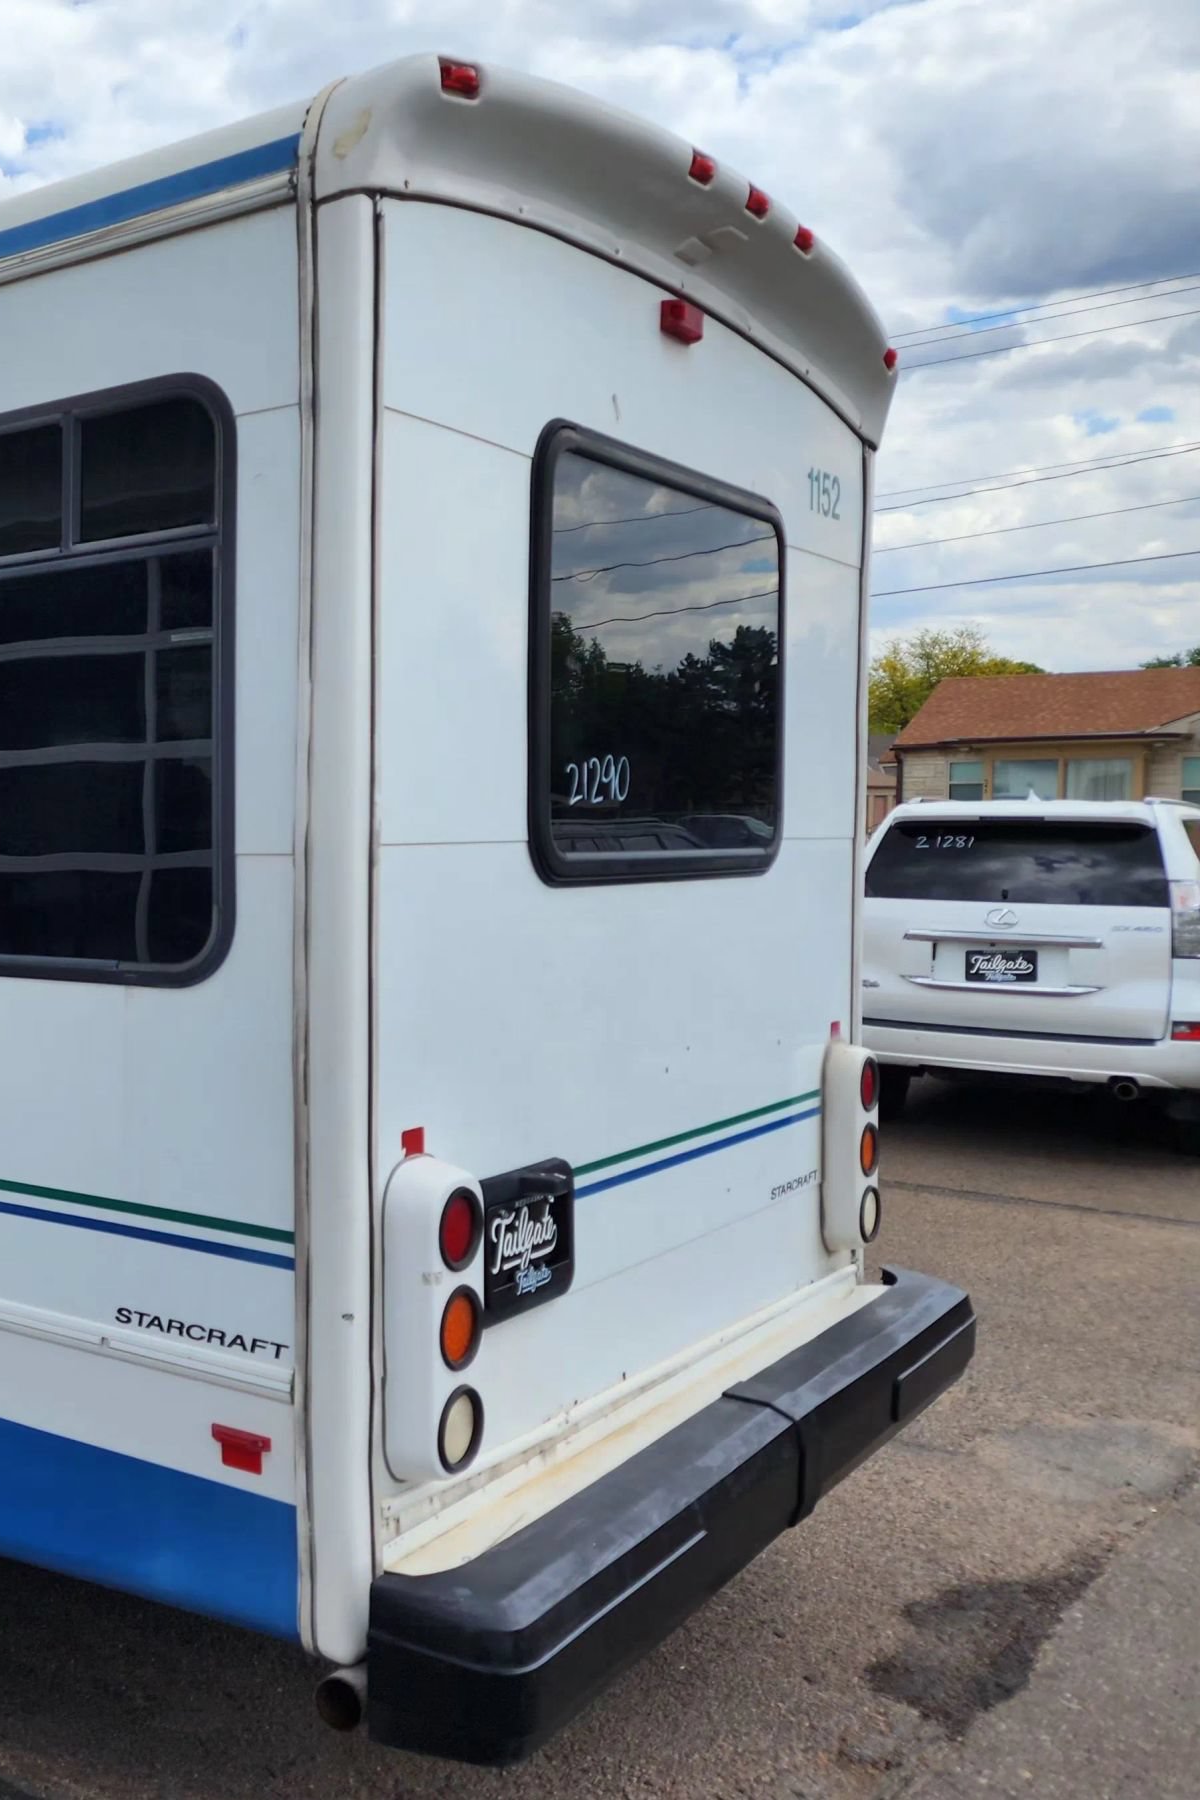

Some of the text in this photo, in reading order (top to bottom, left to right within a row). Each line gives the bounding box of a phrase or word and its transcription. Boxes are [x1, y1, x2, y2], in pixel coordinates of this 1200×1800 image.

[808, 466, 841, 521] 1152
[566, 754, 630, 806] 21290
[915, 835, 975, 849] 21281
[969, 954, 1034, 974] Tailgate
[770, 1169, 818, 1201] STARCRAFT
[491, 1204, 558, 1275] Tailgate
[114, 1306, 291, 1360] STARCRAFT
